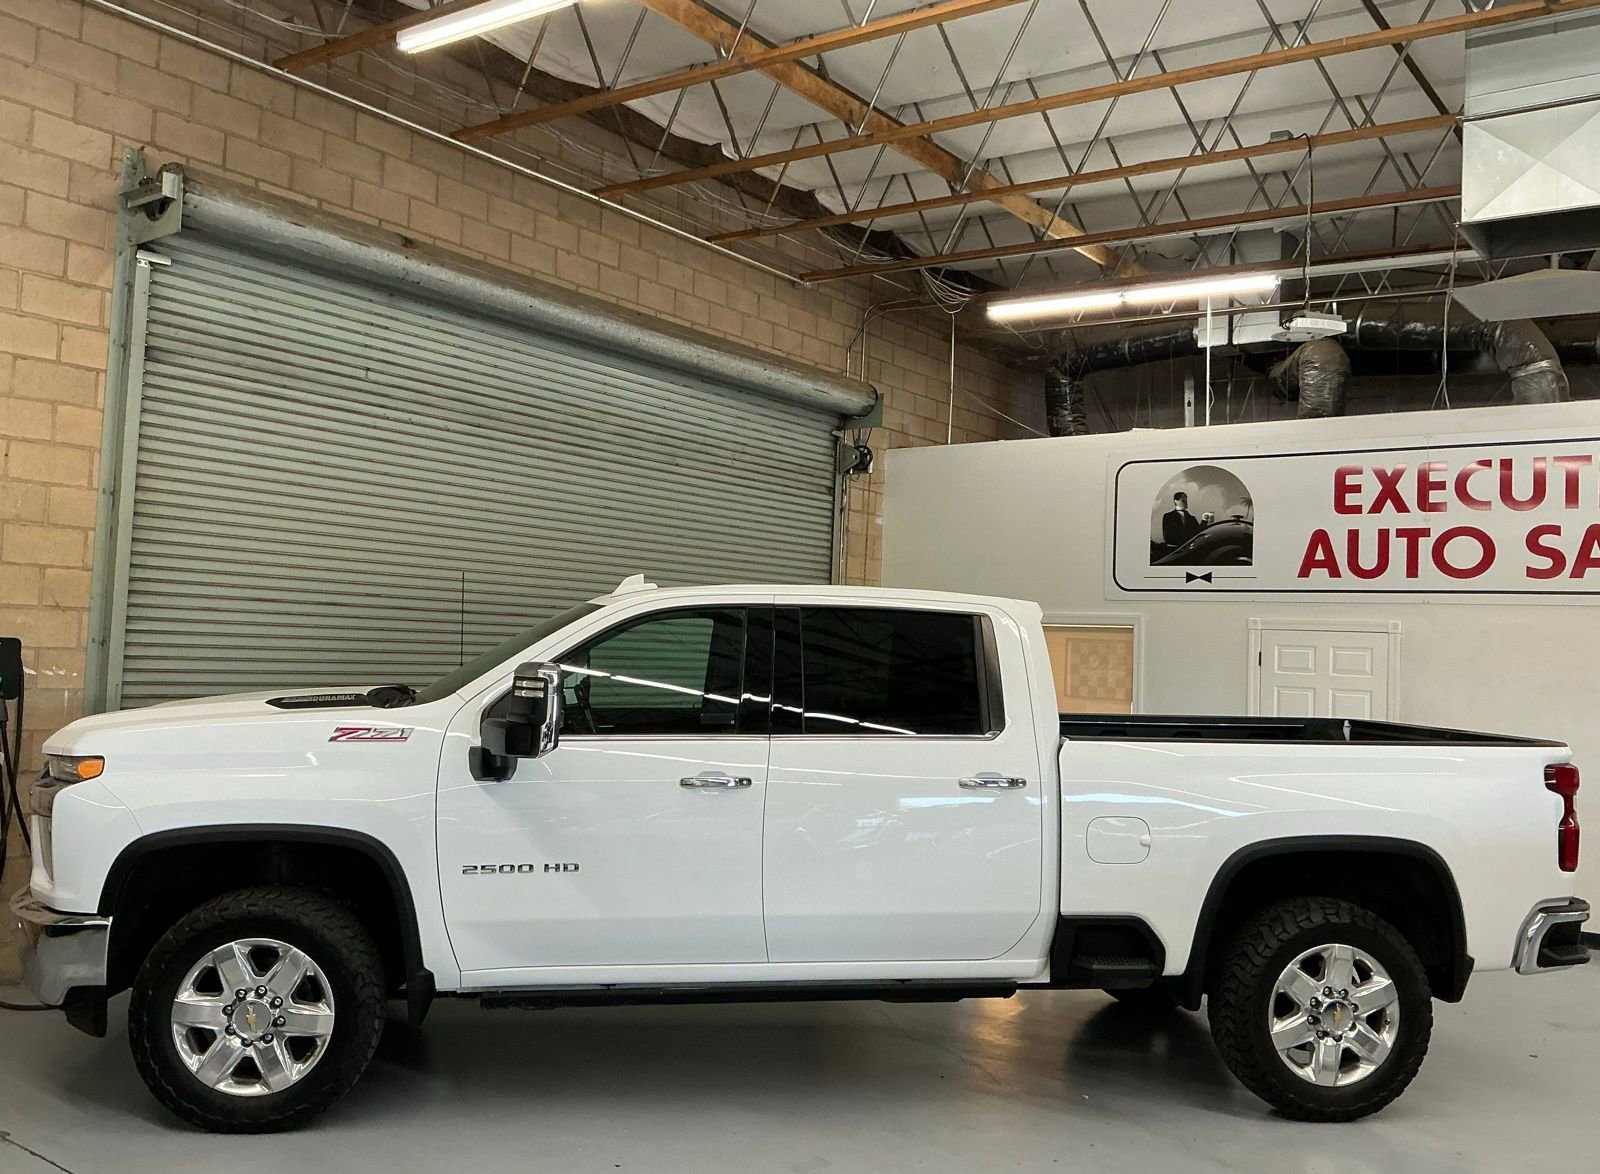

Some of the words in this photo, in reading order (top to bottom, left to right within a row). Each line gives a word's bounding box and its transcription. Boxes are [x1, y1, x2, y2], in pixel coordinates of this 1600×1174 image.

[1334, 454, 1600, 515] EXECUT
[1297, 525, 1496, 579] AUTO
[1525, 523, 1600, 579] SA
[312, 694, 356, 702] DURAMAX
[328, 727, 415, 743] Z71
[462, 863, 535, 875] 2500
[543, 863, 580, 873] HD
